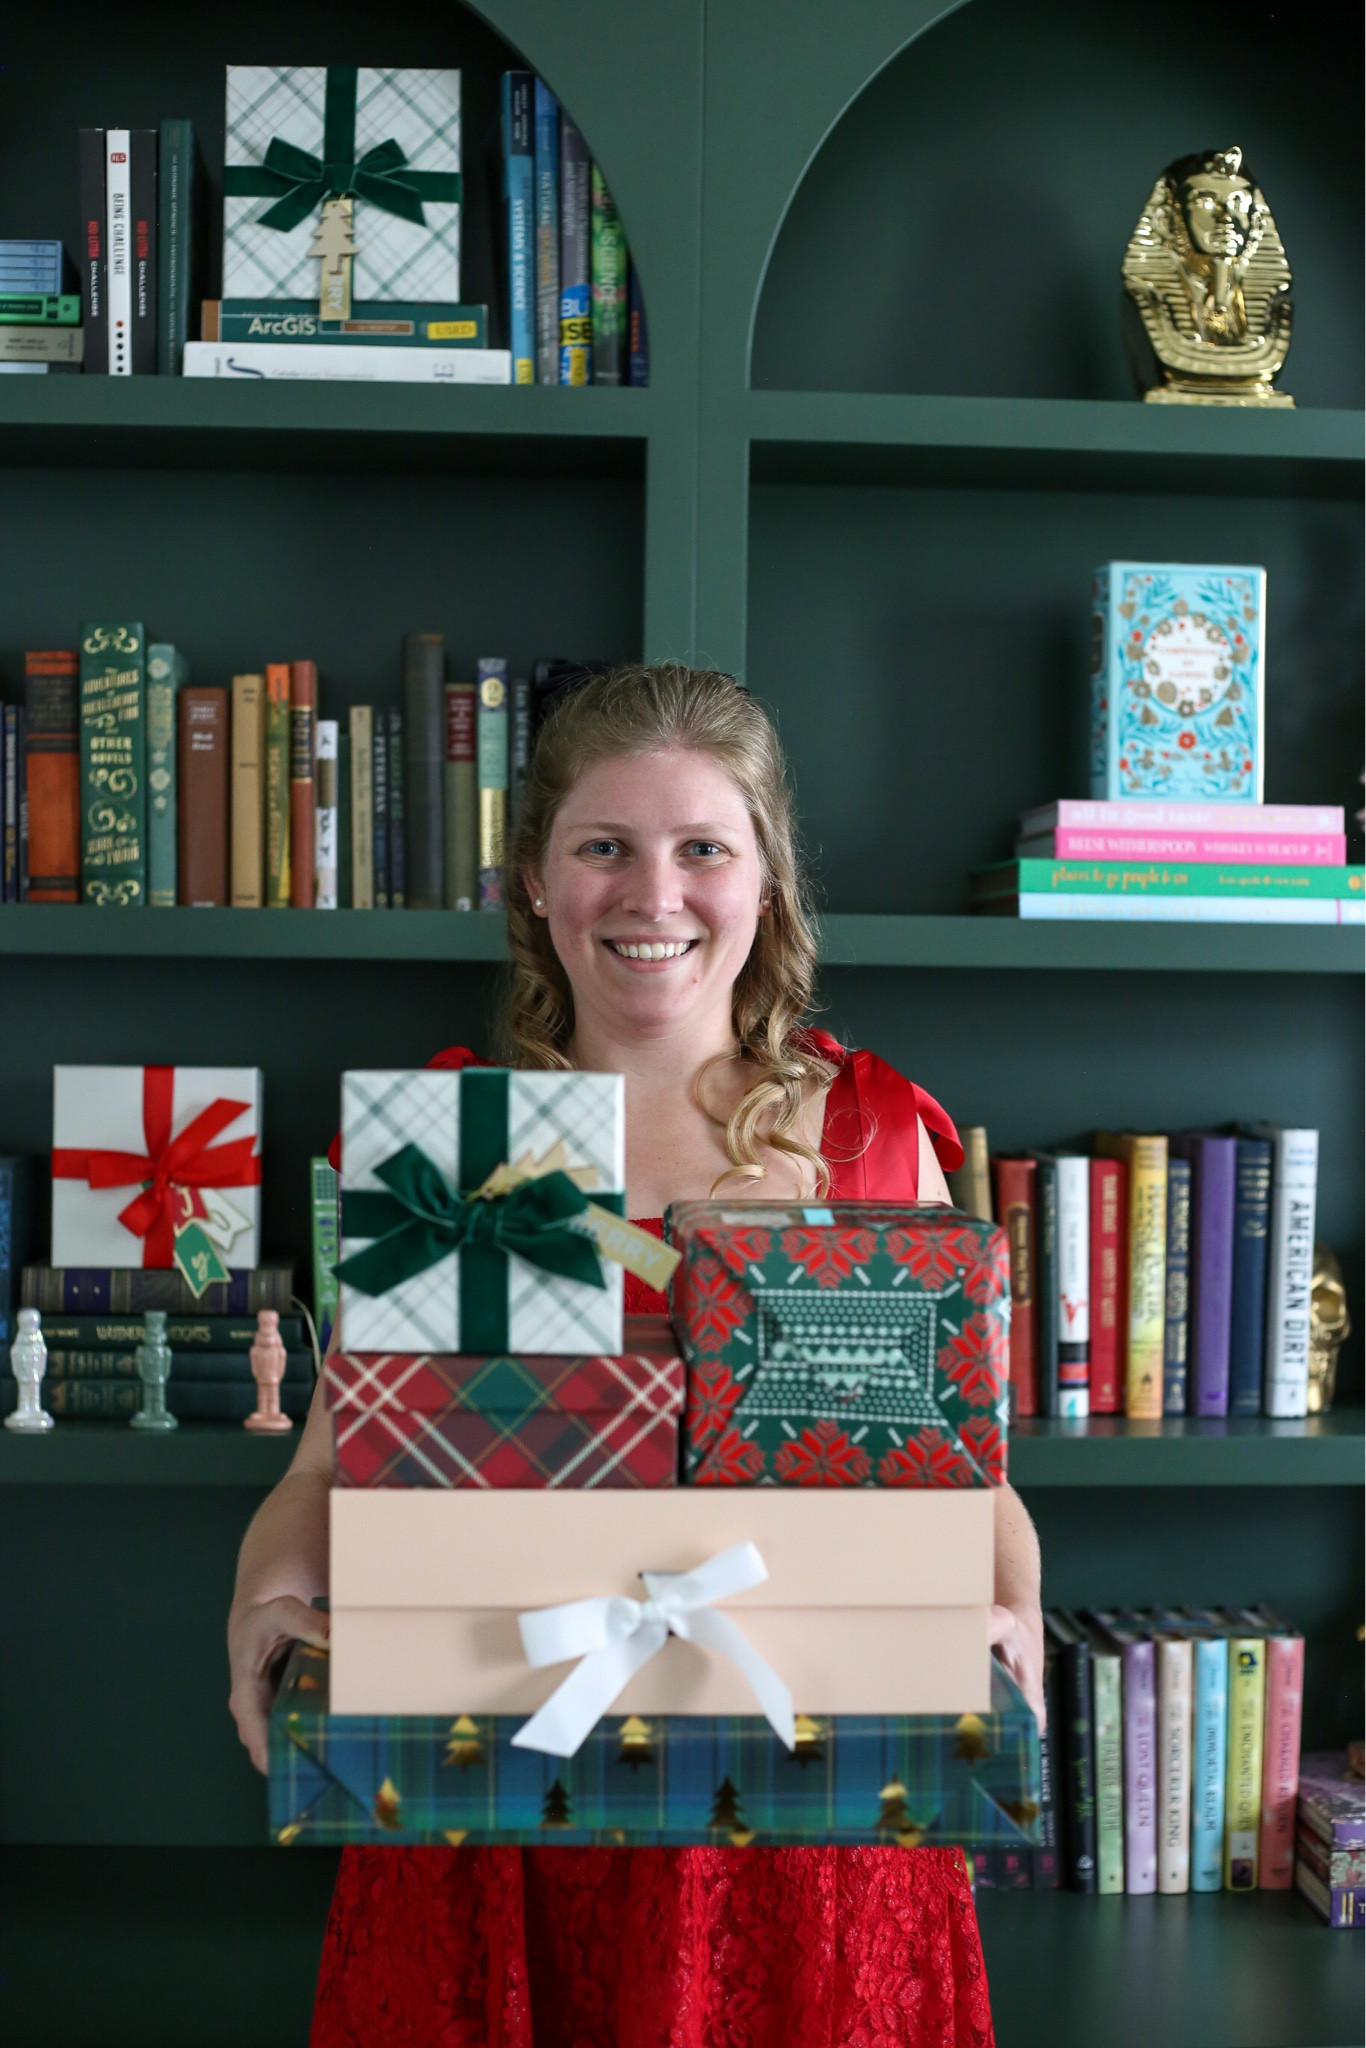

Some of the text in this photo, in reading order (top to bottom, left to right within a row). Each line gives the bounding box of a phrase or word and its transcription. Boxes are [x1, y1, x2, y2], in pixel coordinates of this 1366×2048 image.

[112, 193, 125, 276] BEING CHALLENGE
[513, 199, 527, 244] SYSTEMS
[90, 260, 99, 316] CHALLENGE
[138, 260, 147, 316] CHALLENGE
[512, 264, 526, 310] SCIENCE
[599, 235, 619, 306] SCIENCE
[248, 316, 318, 336] ArcGIS
[90, 736, 133, 750] OTHER
[90, 751, 132, 765] NOVELS
[375, 735, 387, 785] PETER
[1067, 836, 1104, 853] REESE
[1105, 837, 1198, 856] WITHERSPOON
[1146, 1184, 1165, 1324] HARRY POTTER
[1283, 1200, 1311, 1365] AMERICAN DIRT
[1135, 1732, 1153, 1769] LOST
[1166, 1727, 1185, 1805] SORCERER
[1204, 1726, 1220, 1787] IMMORTAL
[1239, 1724, 1255, 1799] ENCHANTED
[1102, 1792, 1119, 1832] PATH
[1134, 1773, 1151, 1828] QUEEN
[1204, 1791, 1218, 1832] REALM
[1238, 1803, 1253, 1832] QUES
[1165, 1810, 1184, 1849] KING
